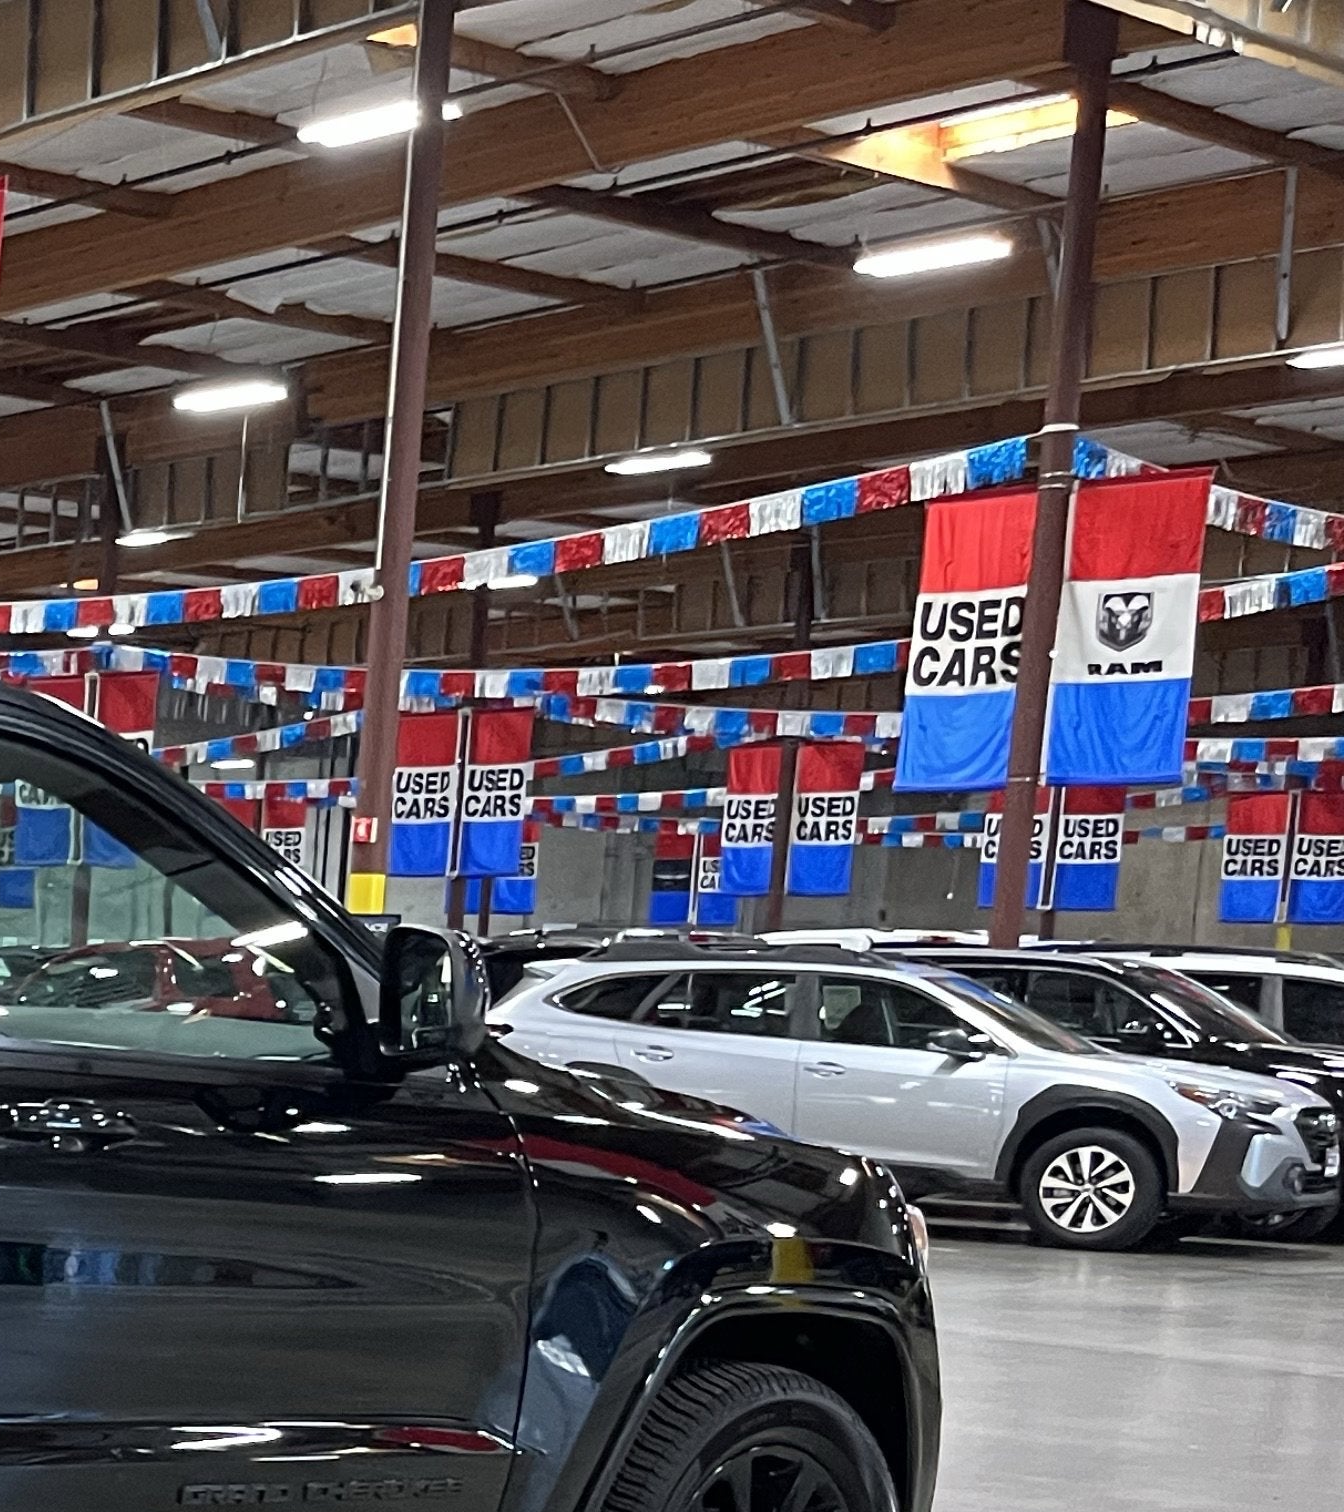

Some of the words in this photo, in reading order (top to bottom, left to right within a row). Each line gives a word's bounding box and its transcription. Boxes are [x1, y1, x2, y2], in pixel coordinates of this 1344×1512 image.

[919, 596, 1027, 641] USED
[912, 641, 1022, 687] CARS
[1087, 660, 1163, 676] RAM
[395, 771, 451, 795] USED
[468, 768, 525, 792] USED
[394, 796, 450, 819] CARS
[464, 794, 522, 818] CARS
[796, 796, 855, 818] USED
[724, 821, 776, 843] CARS
[796, 819, 853, 841] CARS
[986, 818, 1044, 837] UD
[1063, 818, 1120, 838] USED
[984, 840, 1042, 859] CS
[1059, 840, 1118, 860] CARS
[1226, 838, 1282, 857] USED
[1296, 838, 1344, 858] USE
[1224, 858, 1279, 877] CARS
